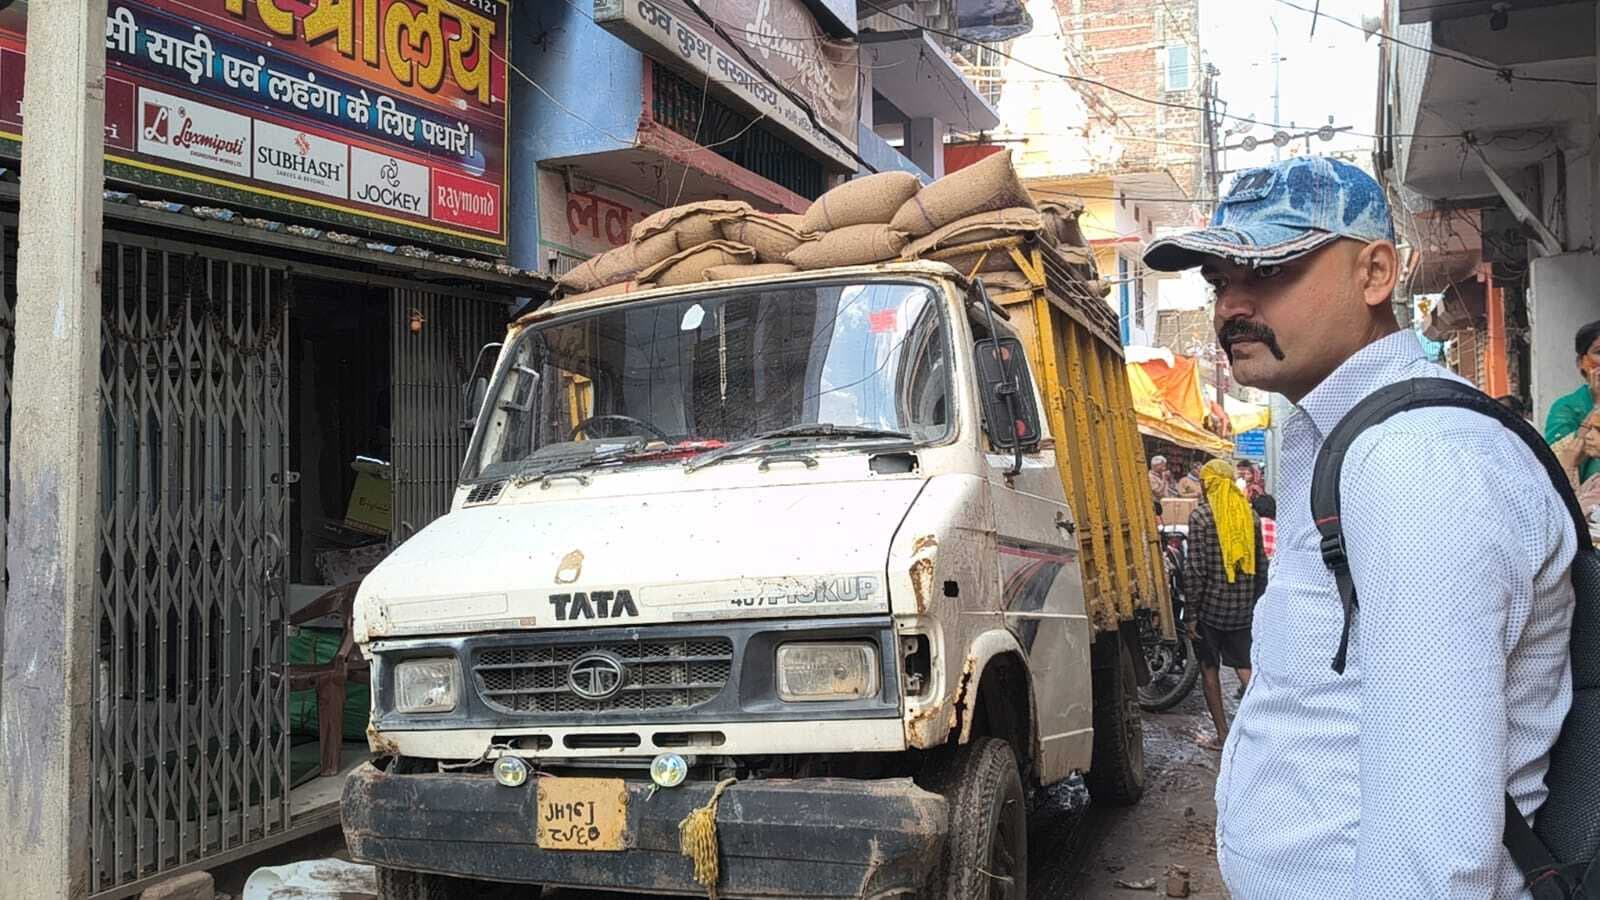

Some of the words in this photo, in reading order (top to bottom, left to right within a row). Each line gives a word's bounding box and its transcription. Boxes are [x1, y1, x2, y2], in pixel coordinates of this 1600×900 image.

[637, 0, 673, 35] लव
[676, 21, 713, 65] कुश
[146, 29, 215, 85] साड़ी
[221, 55, 266, 92] एवं
[267, 69, 342, 117] लहंगा
[346, 88, 371, 124] के
[376, 95, 417, 141] लिए
[257, 145, 341, 182] SUBHASH
[357, 183, 421, 212] JOCKEY
[438, 185, 495, 217] Raymond
[566, 191, 633, 246] लव
[548, 589, 640, 621] TATA
